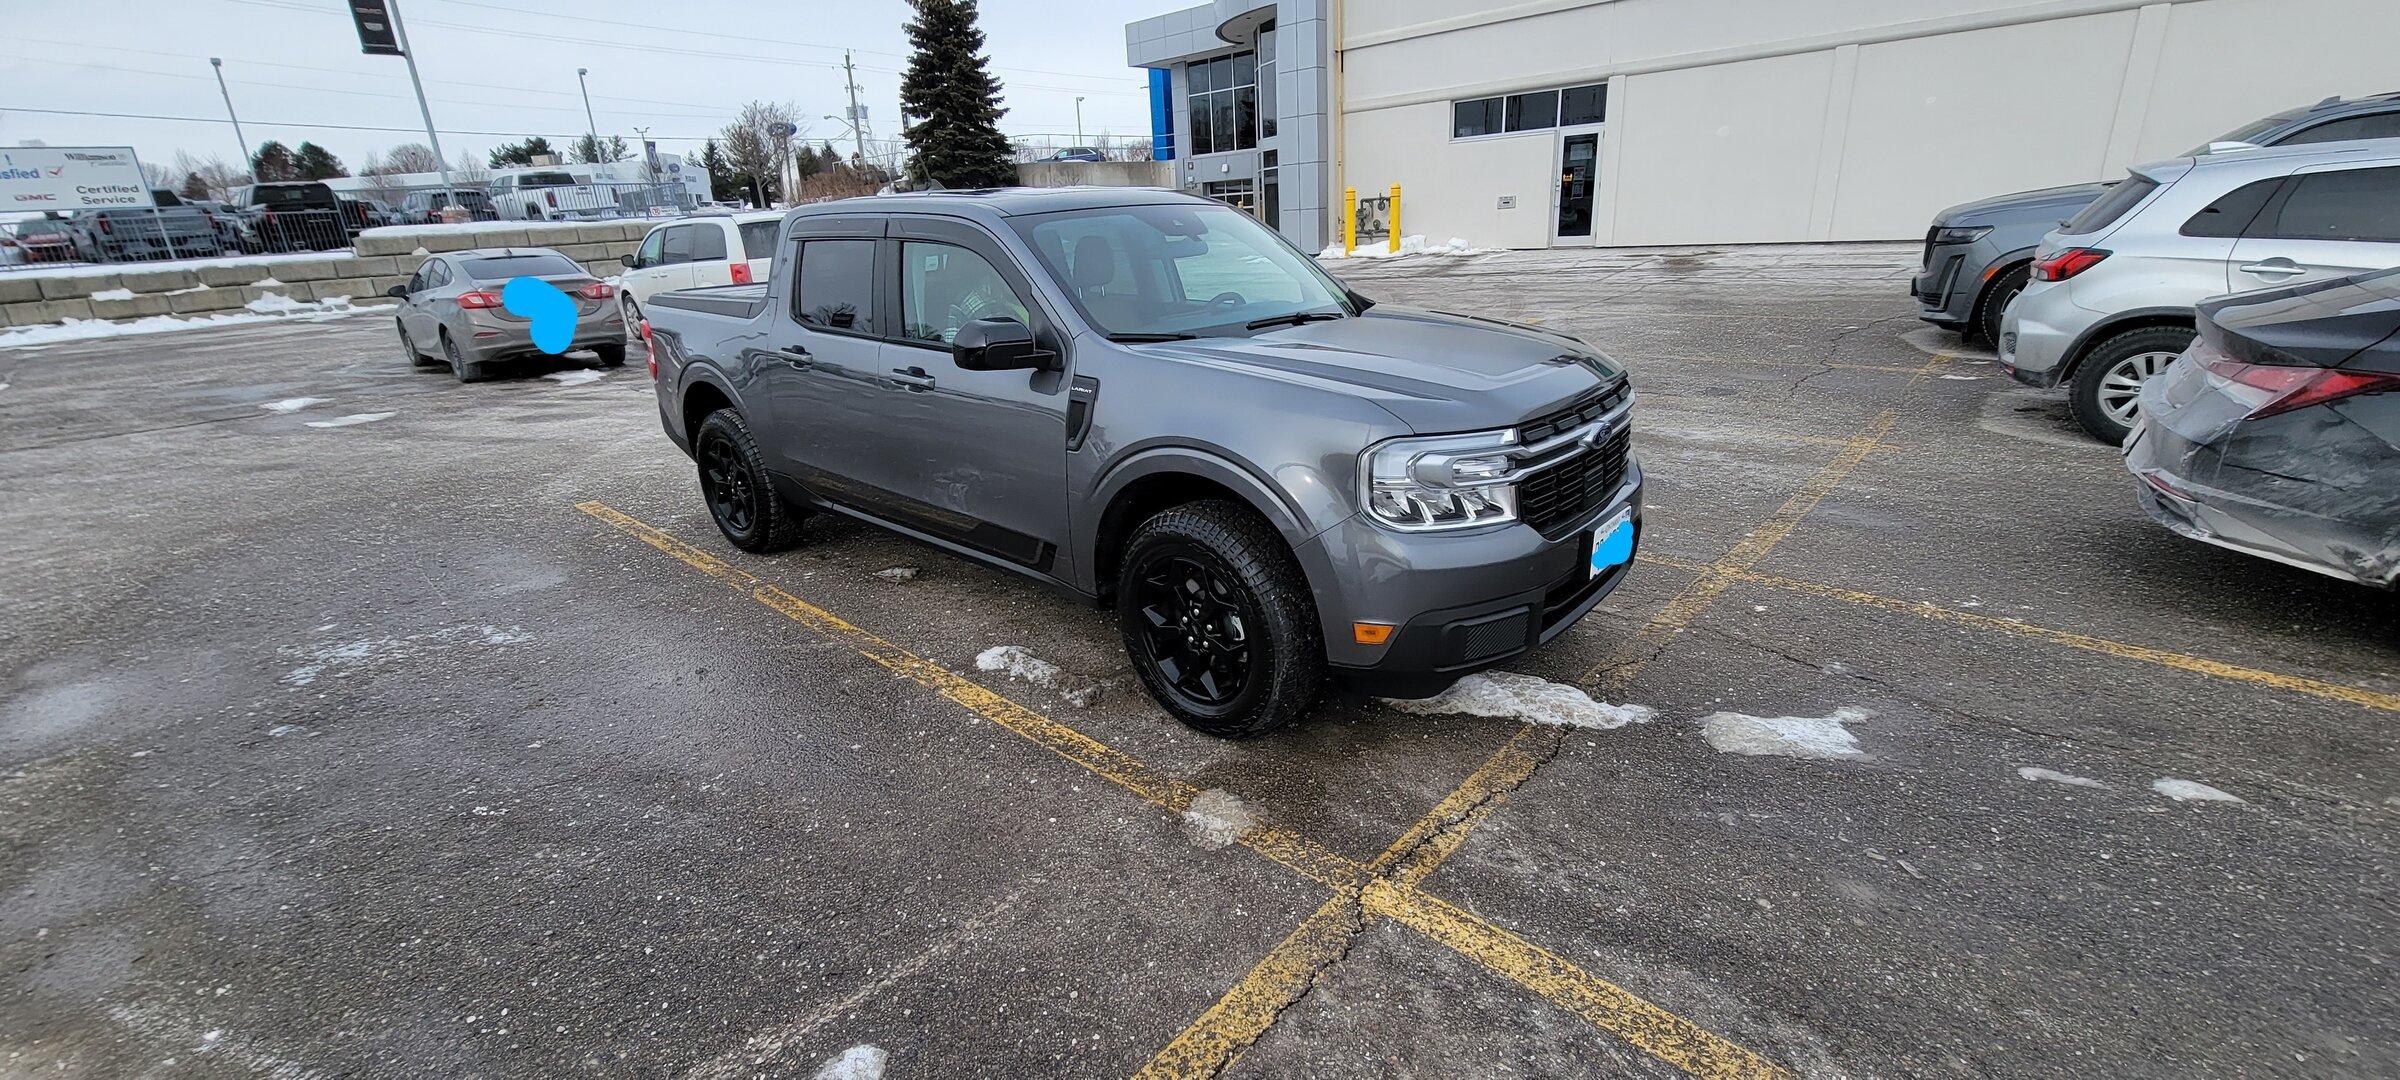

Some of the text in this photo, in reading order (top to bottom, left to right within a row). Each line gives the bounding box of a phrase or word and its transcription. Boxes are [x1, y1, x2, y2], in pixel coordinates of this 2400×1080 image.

[76, 184, 140, 195] Certified
[14, 193, 57, 202] GMC
[81, 195, 137, 205] Service
